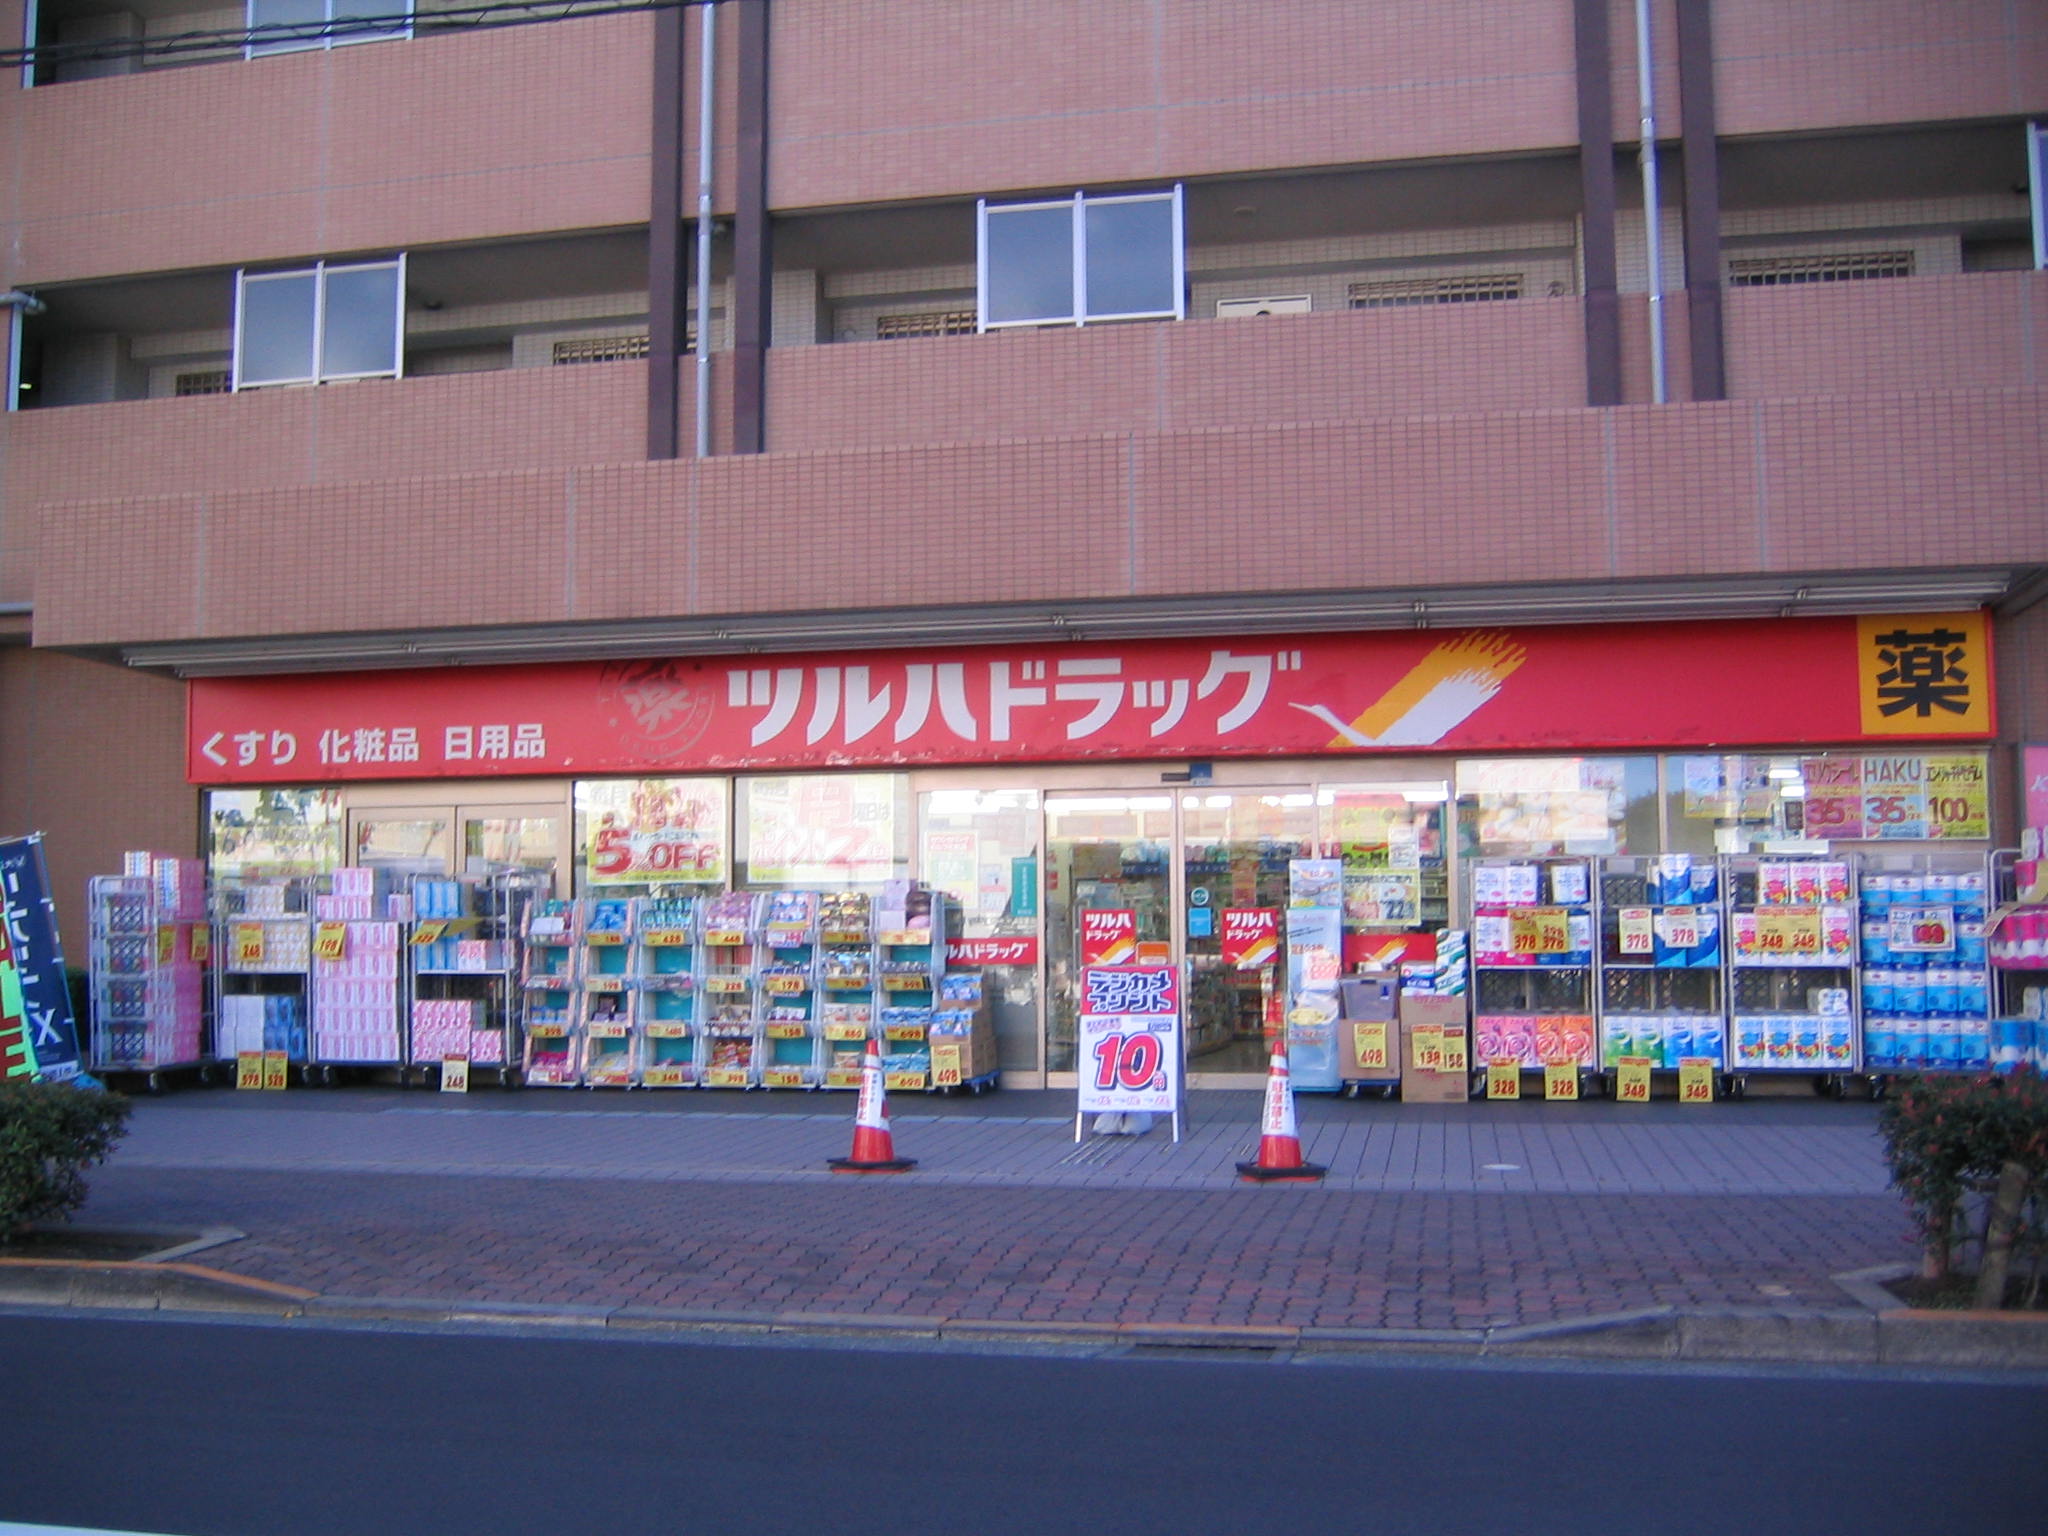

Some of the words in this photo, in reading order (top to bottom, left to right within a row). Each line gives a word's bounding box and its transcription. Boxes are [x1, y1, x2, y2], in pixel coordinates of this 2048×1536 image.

[1875, 629, 1971, 718] 薬
[727, 650, 1301, 747] ツルハドラッグ
[202, 729, 297, 766] くすり
[319, 726, 419, 764] 化粧品
[444, 723, 546, 761] 日用品
[1864, 759, 1921, 783] HAKU
[1806, 796, 1845, 824] 35
[1866, 797, 1906, 824] 35
[1928, 796, 1969, 824] 100
[1085, 913, 1132, 928] ツルハ
[1226, 913, 1273, 928] ツルハ
[1086, 929, 1121, 941] ドラッグ
[1227, 929, 1263, 941] ドラッグ
[1515, 935, 1536, 949] 378
[1627, 934, 1649, 949] 378
[1672, 929, 1694, 943] 378
[1761, 934, 1783, 948] 348
[1793, 934, 1815, 948] 348
[1087, 970, 1172, 993] デジカメ
[1088, 993, 1172, 1013] プリント
[1494, 1080, 1516, 1094] 328
[1552, 1080, 1574, 1095] 328
[1623, 1082, 1645, 1097] 348
[1686, 1085, 1708, 1099] 348
